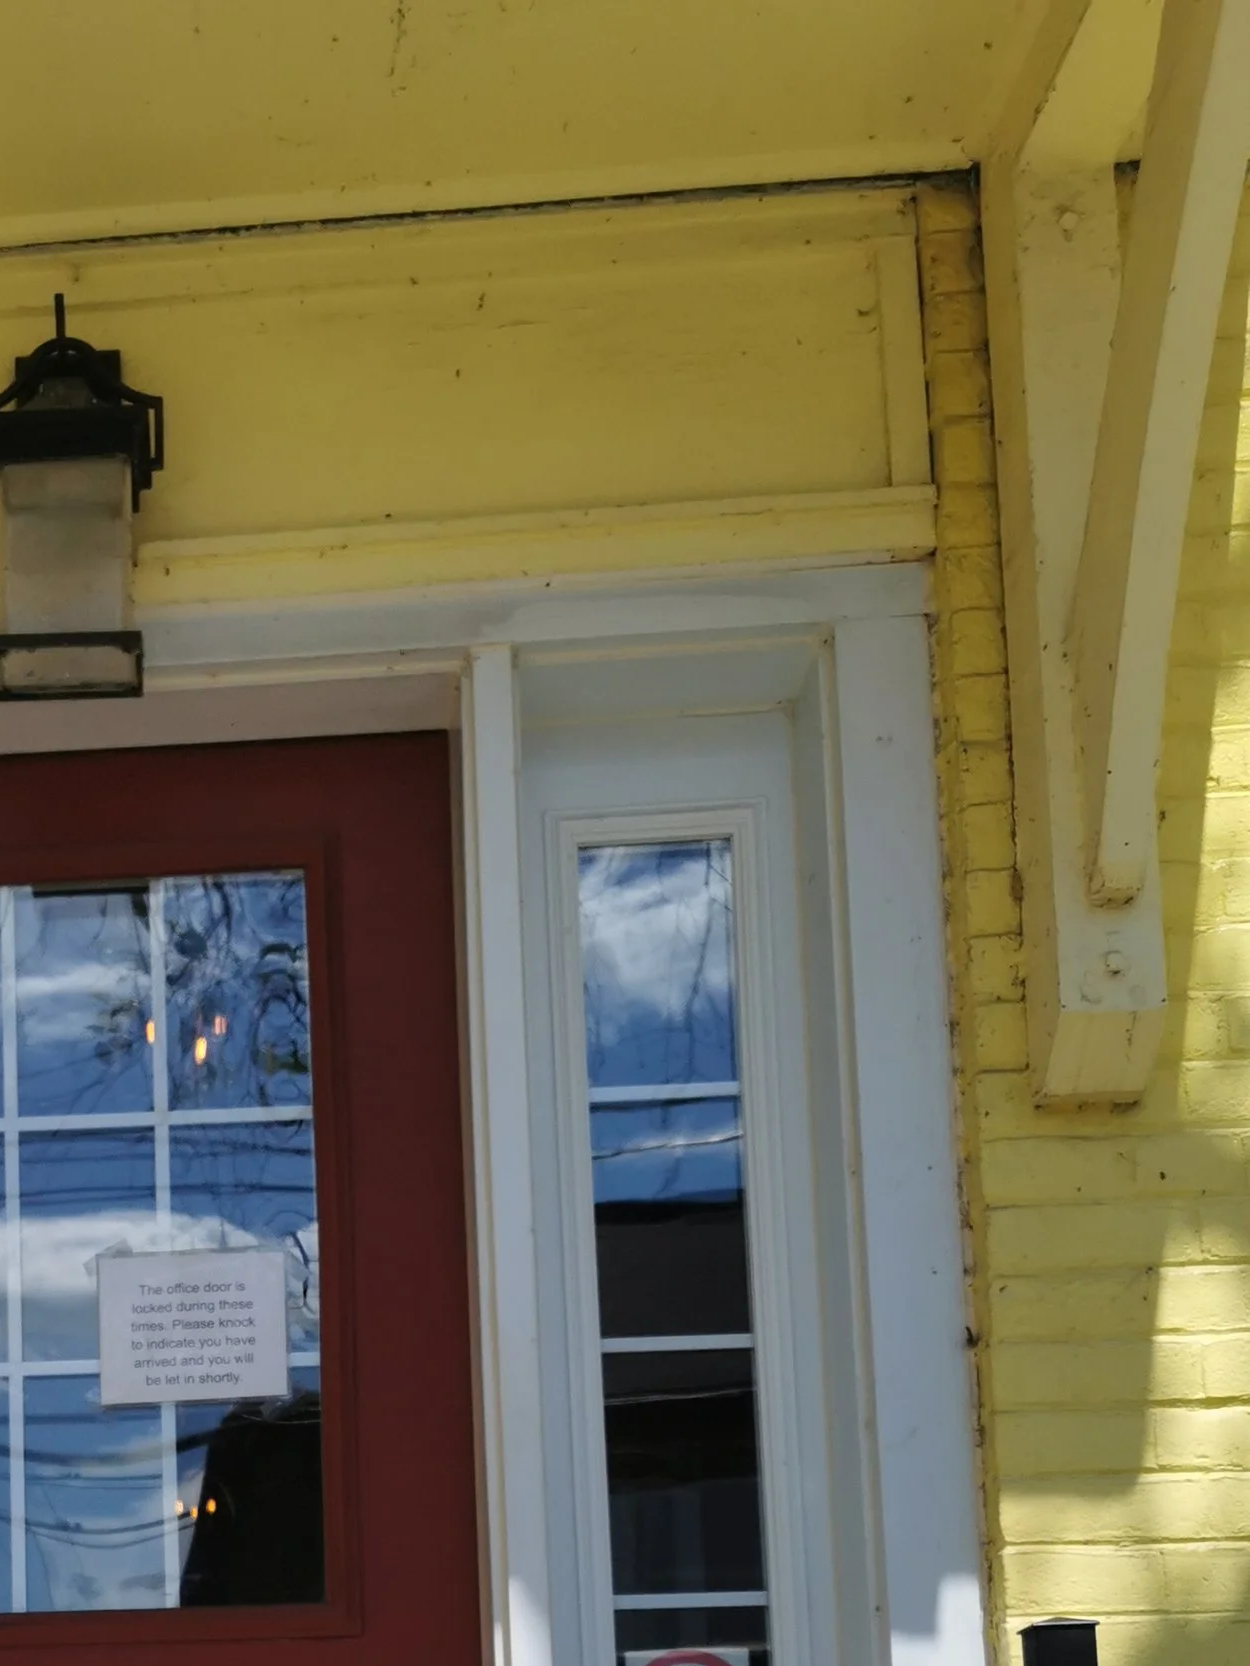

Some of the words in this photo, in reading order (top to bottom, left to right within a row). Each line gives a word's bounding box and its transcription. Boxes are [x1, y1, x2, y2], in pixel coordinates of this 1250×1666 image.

[139, 1285, 162, 1296] The
[167, 1283, 199, 1294] office
[204, 1282, 231, 1293] door
[236, 1282, 245, 1291] is
[132, 1302, 172, 1314] locked
[177, 1301, 214, 1313] during
[219, 1300, 253, 1310] these
[131, 1321, 167, 1332] times.
[173, 1319, 214, 1330] Please
[219, 1317, 256, 1328] knock
[132, 1340, 143, 1351] to
[147, 1338, 195, 1350] indicate
[199, 1339, 221, 1349] you
[226, 1336, 255, 1346] have
[134, 1356, 176, 1368] arrived
[181, 1355, 204, 1365] and
[208, 1357, 230, 1367] you
[234, 1353, 254, 1364] will
[146, 1375, 161, 1386] be
[165, 1374, 180, 1385] let
[185, 1373, 194, 1384] in
[199, 1371, 242, 1385] shortly.
